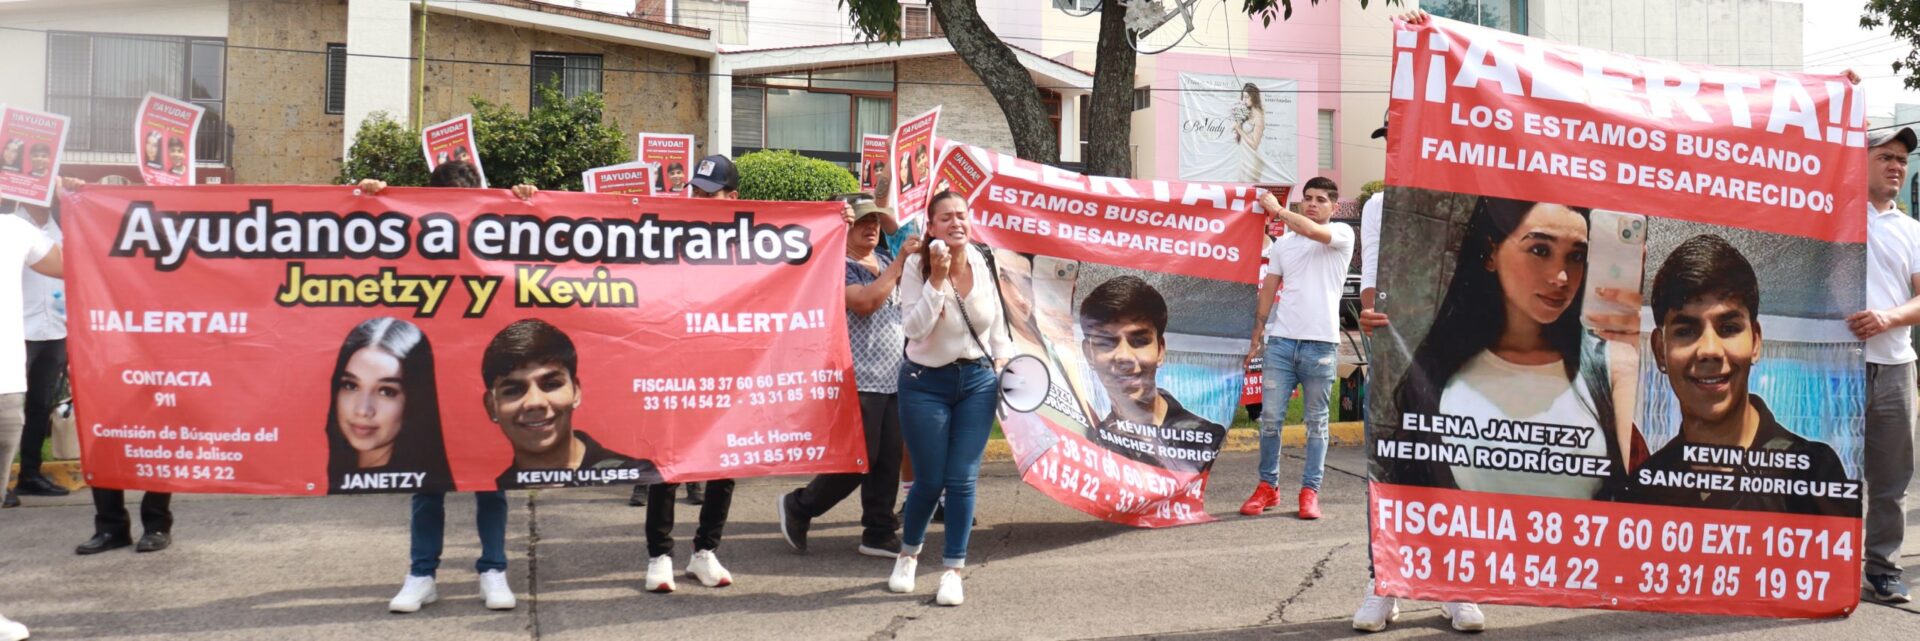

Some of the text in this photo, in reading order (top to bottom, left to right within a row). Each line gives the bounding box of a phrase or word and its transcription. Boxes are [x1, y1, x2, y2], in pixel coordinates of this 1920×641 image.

[1450, 103, 1822, 177] LOS ESTAMOS BUSCANDO
[1421, 138, 1835, 215] FAMILIARES DESAPARECIDOS
[988, 184, 1226, 235] ESTAMOS BUSCANDO
[117, 205, 810, 266] Ayudanos a encontrarlos
[1057, 223, 1240, 262] DESAPARECIDOS
[279, 266, 636, 315] Janetzy y Kevin
[89, 310, 248, 334] !!ALERTA!!
[685, 309, 826, 333] !!ALERTA!!
[121, 370, 212, 387] CONTACTA
[632, 378, 696, 393] FISCALIA
[699, 377, 715, 391] 38
[718, 376, 733, 390] 37
[736, 374, 753, 389] 60
[756, 372, 773, 388] 60
[776, 371, 807, 388] EXT.
[154, 393, 176, 407] 911
[644, 396, 660, 410] 33
[663, 395, 677, 410] 15
[681, 394, 696, 409] 14
[699, 393, 713, 408] 54
[716, 392, 731, 408] 22
[749, 391, 766, 406] 33
[768, 390, 783, 405] 31
[787, 389, 803, 402] 85
[810, 387, 826, 400] 19
[826, 386, 840, 400] 97
[92, 424, 279, 446] Comisión de Búsqueda del
[727, 430, 812, 448] Back Home
[1099, 428, 1156, 455] SANCHEZ
[1116, 419, 1213, 444] KEVIN ULISES
[1401, 412, 1595, 448] ELENA JANETZY
[124, 444, 243, 462] Estado de Jalisco
[719, 446, 825, 466] 33 31 85 19 97
[1061, 435, 1081, 462] 38
[1082, 446, 1099, 471] 37
[1102, 450, 1121, 482] 60
[1122, 464, 1143, 489] 60
[1376, 440, 1612, 477] MEDINA RODRÍGUEZ
[1683, 445, 1811, 471] KEVIN ULISES
[136, 463, 235, 480] 33 15 14 54 22
[340, 472, 426, 490] JANETZY
[516, 468, 640, 483] KEVIN ULISES
[1041, 456, 1058, 484] 14
[1060, 464, 1080, 493] 54
[1080, 473, 1100, 502] 22
[1115, 488, 1135, 513] 33
[1639, 469, 1859, 499] SANCHEZ RODRIGUEZ
[1377, 499, 1854, 562] FISCALIA 38 37 60 60 EXT. 16714
[1400, 546, 1432, 580] 33
[1443, 548, 1475, 582] 15
[1485, 552, 1516, 585] 14
[1524, 555, 1558, 588] 54
[1566, 557, 1600, 590] 22
[1638, 561, 1670, 594] 33
[1676, 563, 1703, 594] 31
[1711, 565, 1741, 597] 85
[1755, 567, 1786, 599] 19
[1796, 570, 1830, 601] 97
